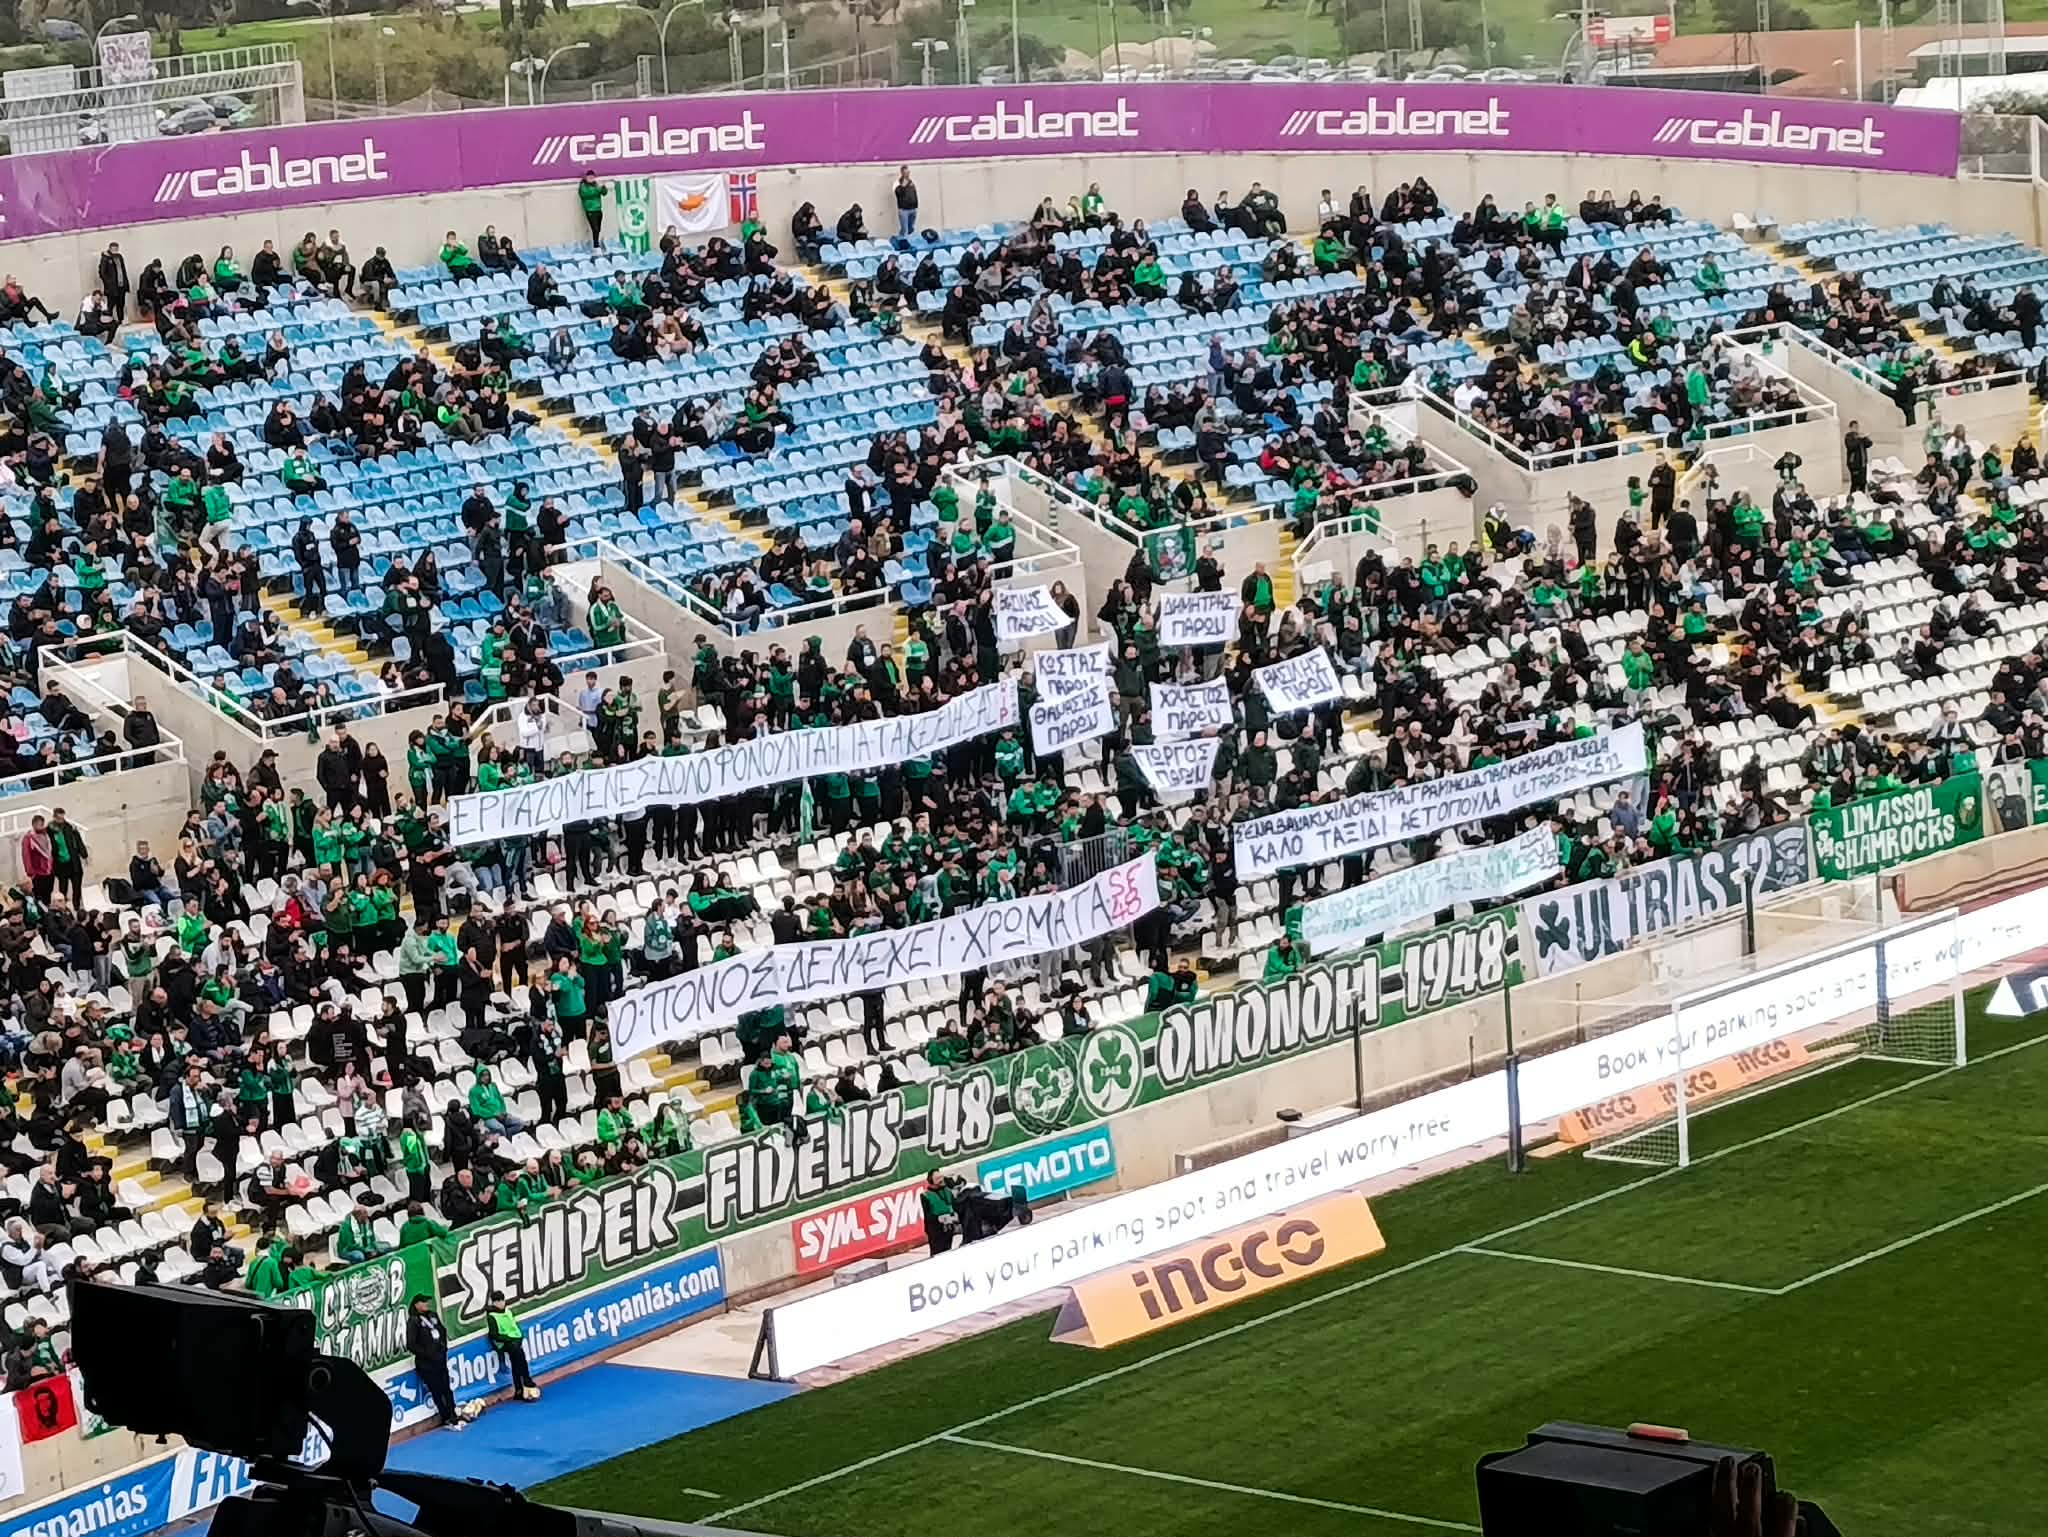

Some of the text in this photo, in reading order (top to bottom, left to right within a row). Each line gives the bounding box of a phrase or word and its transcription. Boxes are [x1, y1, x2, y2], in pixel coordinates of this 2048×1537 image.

[571, 110, 764, 160] cablenet
[945, 97, 1139, 142] cablenet
[1316, 97, 1510, 137] cablenet
[1690, 108, 1885, 155] cablenet
[190, 138, 388, 197] cablenet
[1040, 651, 1102, 676] ΚΩΣΤΑΣ
[1250, 785, 1501, 868] ΚΑΛΟ ΤΑΞΙΔΙ ΑΕΤΟΠΟΥΛΑ
[1841, 788, 1940, 838] LIMASSOL
[1835, 814, 1955, 871] SHAMROCKS
[1574, 850, 1728, 961] ULTRAS
[1159, 922, 1504, 1081] OMONOIA 1948
[1598, 1050, 1648, 1079] Book
[460, 1074, 994, 1318] SEMPER FIDELIS 48
[800, 1208, 866, 1263] SYM
[909, 1272, 975, 1312] Book
[986, 1252, 1040, 1296] your
[1051, 1218, 1145, 1271] parking
[1215, 1180, 1257, 1209] and
[1265, 1157, 1328, 1192] travel
[447, 1350, 500, 1391] Shop
[573, 1308, 597, 1342] at
[600, 1264, 719, 1336] spanias.com
